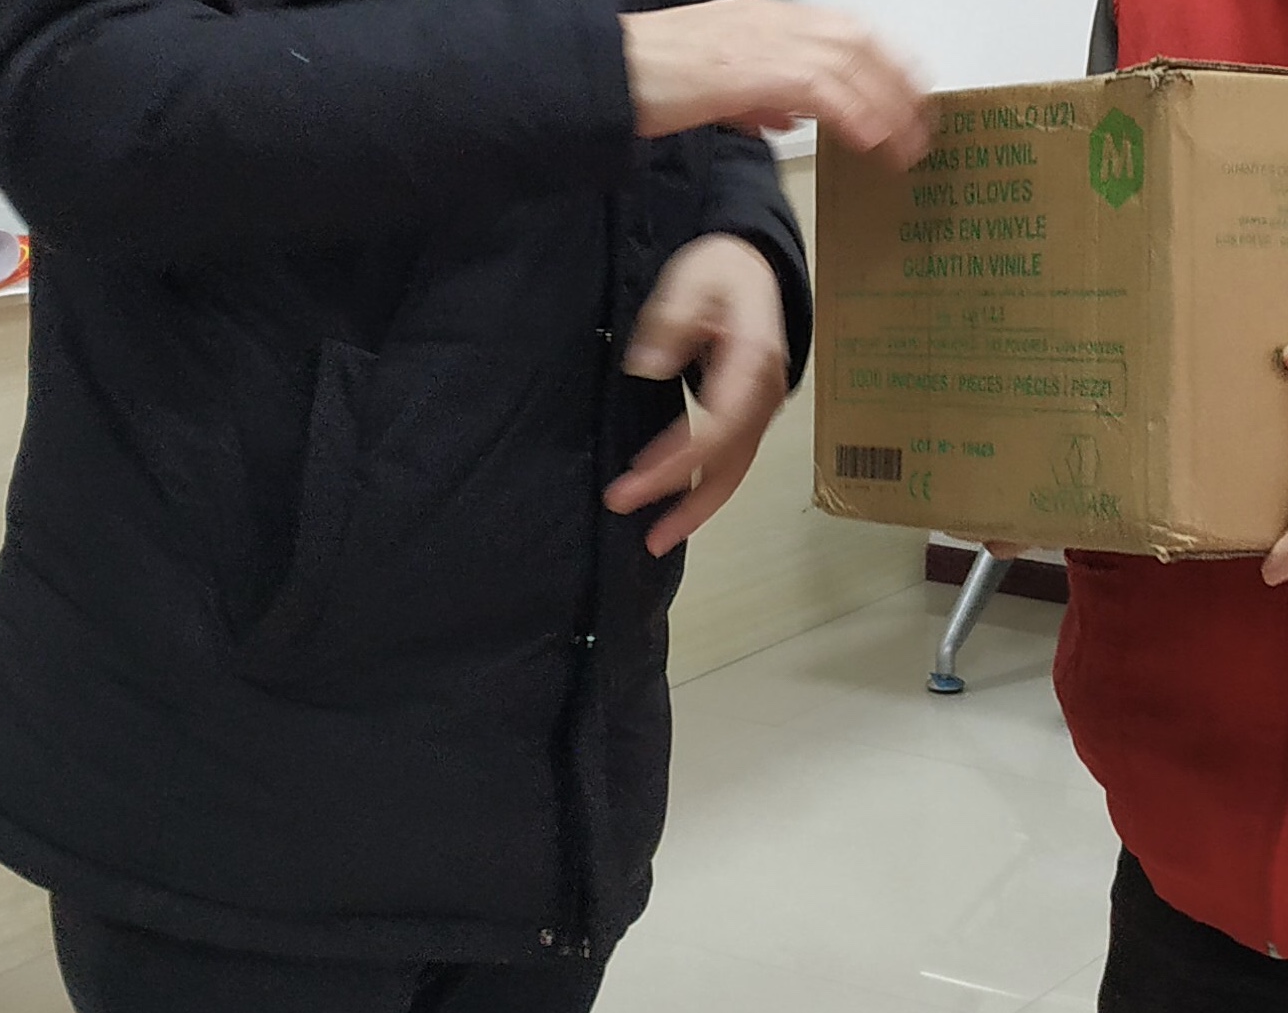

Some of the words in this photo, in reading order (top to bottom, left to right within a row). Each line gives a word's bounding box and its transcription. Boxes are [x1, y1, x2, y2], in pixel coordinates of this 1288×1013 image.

[953, 112, 974, 134] DE
[981, 105, 1039, 130] VINILO
[965, 146, 989, 168] EM
[995, 141, 1037, 167] VINIL
[913, 183, 956, 208] VINYL
[964, 181, 1033, 204] GLOVES
[958, 218, 981, 241] EN
[987, 215, 1047, 239] VINYLE
[967, 255, 981, 277] IN
[989, 253, 1042, 277] VINILE
